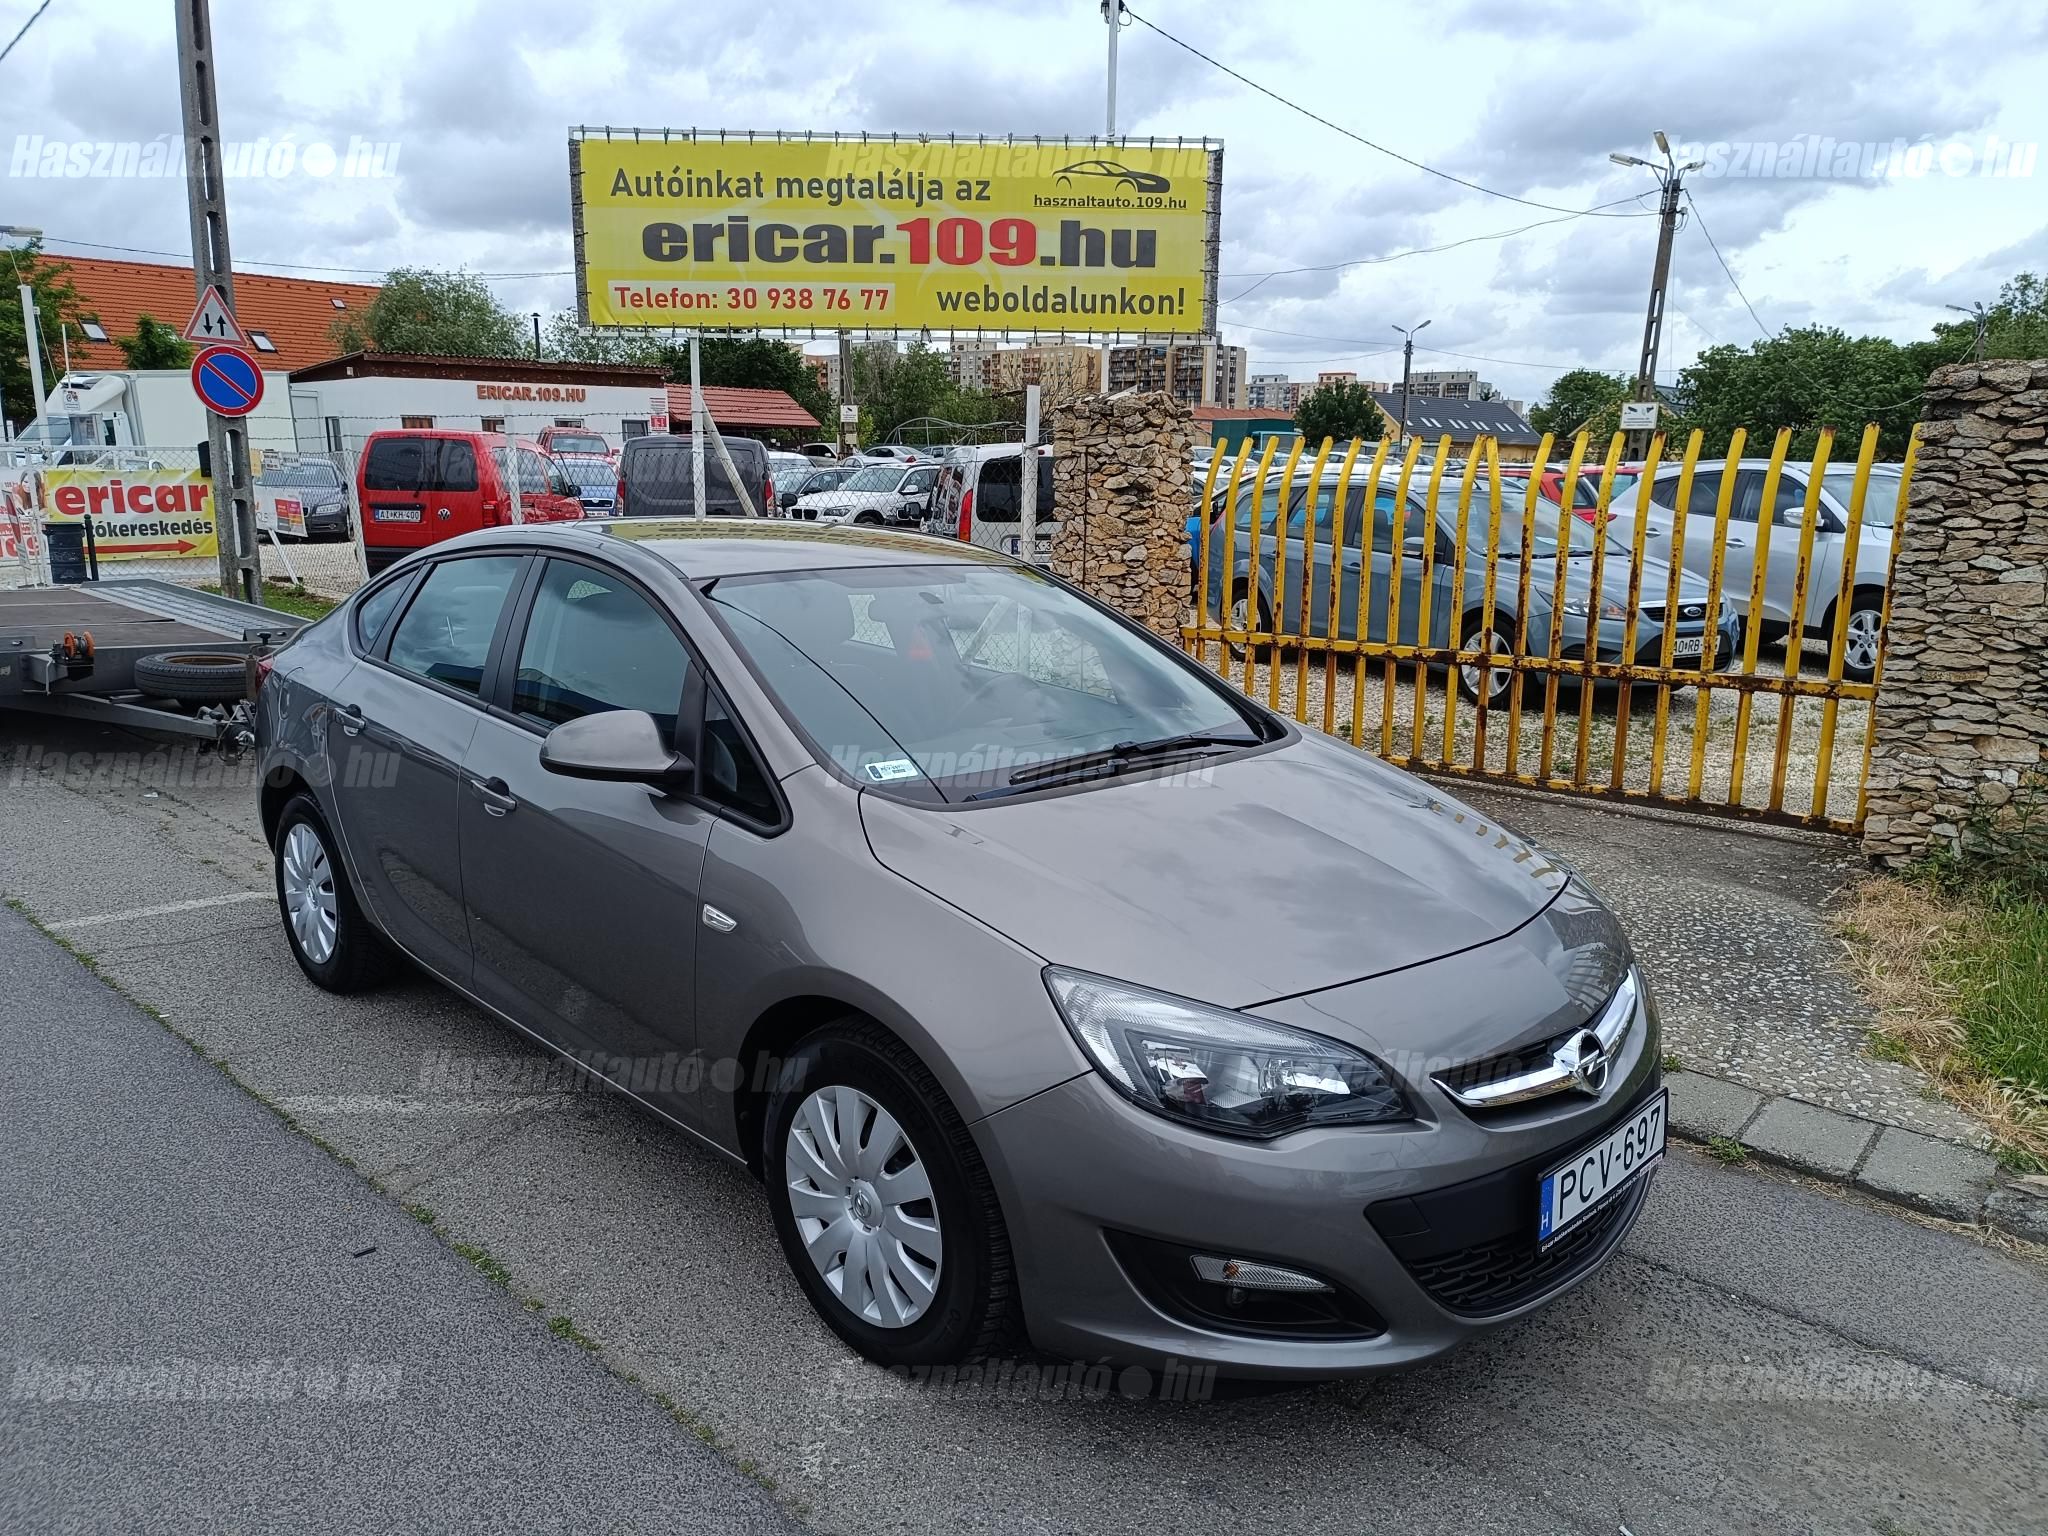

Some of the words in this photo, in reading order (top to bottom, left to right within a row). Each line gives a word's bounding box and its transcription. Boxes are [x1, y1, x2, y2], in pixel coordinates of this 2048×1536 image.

[610, 165, 763, 198] Autóinkat
[776, 168, 943, 207] megtalálja
[956, 179, 991, 201] az
[1034, 194, 1187, 209] hasznaltauto.109.hu
[642, 215, 1157, 269] ericar.109.hu
[614, 286, 718, 310] Telefon:
[727, 288, 757, 310] 30
[768, 288, 813, 311] 938
[822, 289, 852, 311] 76
[860, 289, 889, 311] 77
[937, 284, 1185, 316] weboldalunkon!
[477, 384, 586, 403] ERICAR.109.HU
[55, 479, 209, 516] ericar
[84, 518, 213, 538] ókereskedés
[1558, 1105, 1661, 1221] PCV-697
[1541, 1211, 1549, 1231] H
